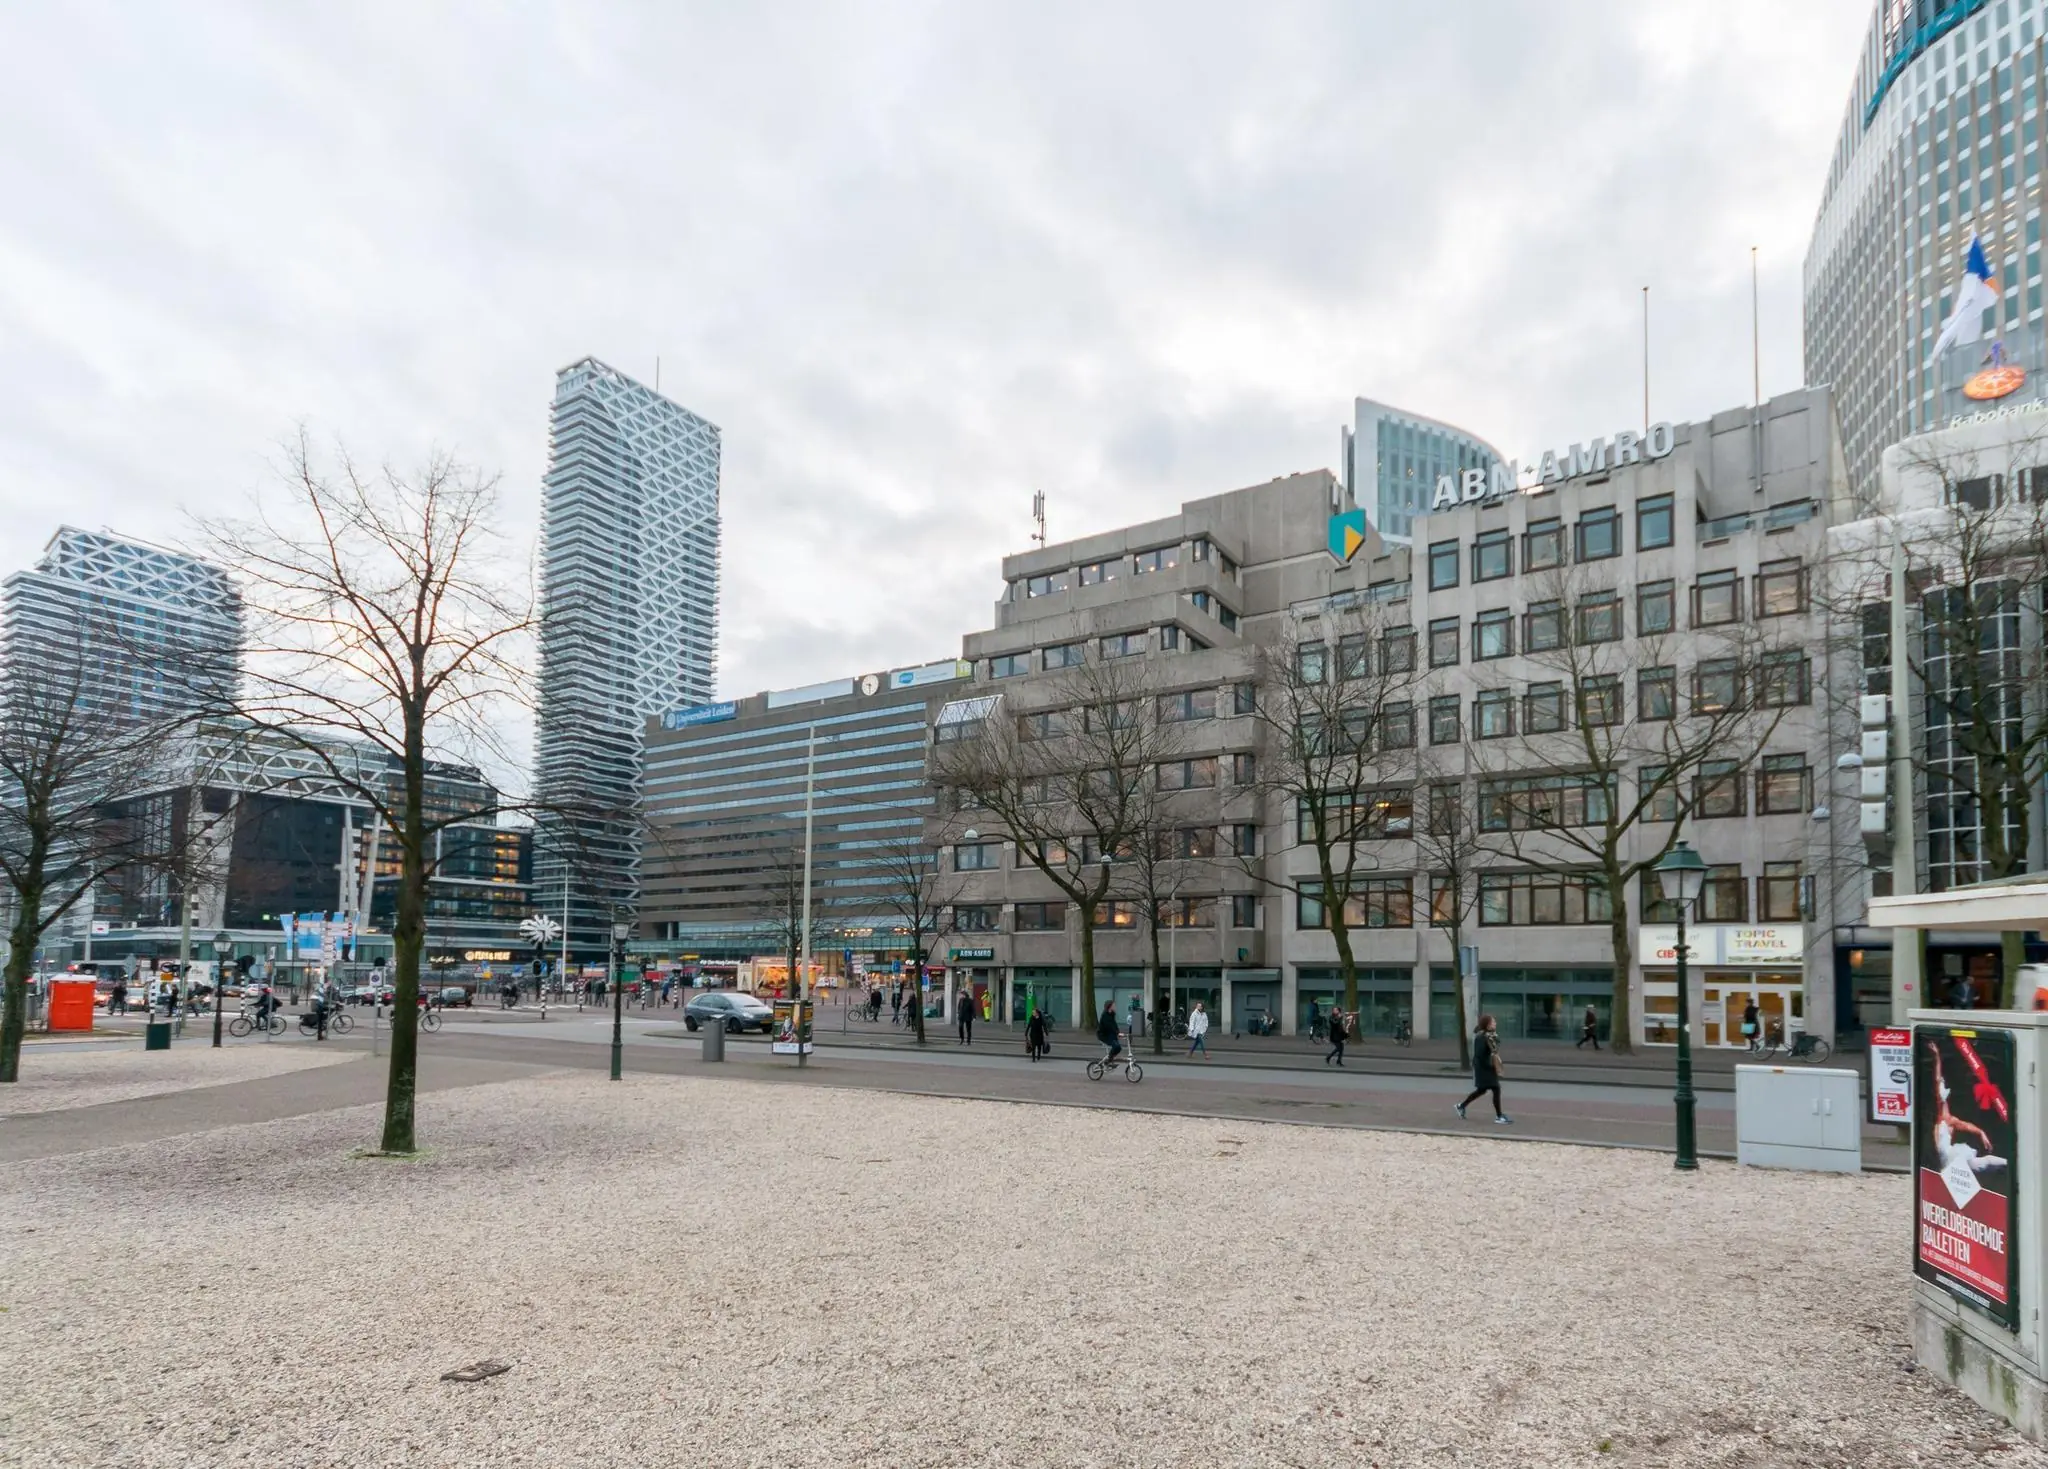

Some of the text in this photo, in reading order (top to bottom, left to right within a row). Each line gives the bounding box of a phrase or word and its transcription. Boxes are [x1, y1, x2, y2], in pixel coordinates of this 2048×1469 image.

[1432, 421, 1675, 511] ABN AMRO
[1735, 929, 1776, 939] TOPIC
[1735, 939, 1787, 949] TRAVEL
[1881, 1100, 1901, 1110] 1+1
[1922, 1199, 2004, 1254] WERELDBEROEMDE
[1922, 1223, 1971, 1265] BALLETTEN
